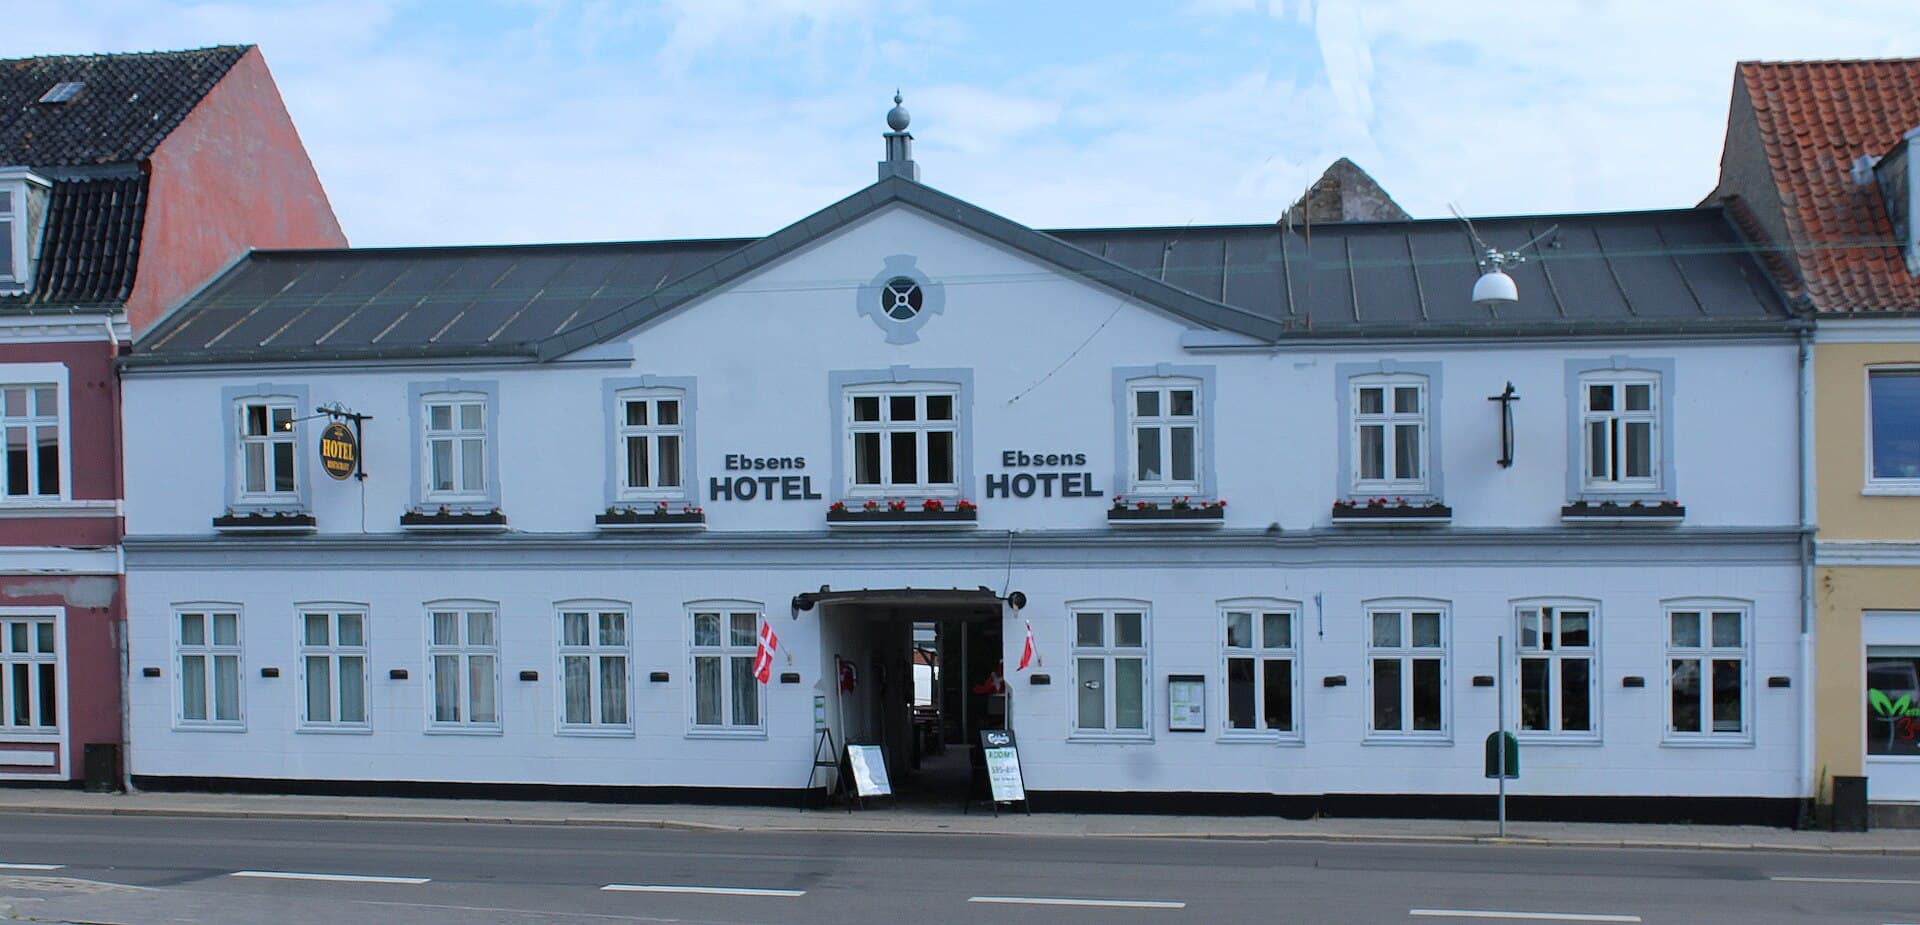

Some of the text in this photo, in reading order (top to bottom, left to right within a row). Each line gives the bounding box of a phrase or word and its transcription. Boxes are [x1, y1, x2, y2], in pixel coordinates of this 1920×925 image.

[322, 438, 354, 460] HOTEL
[1002, 450, 1087, 467] Ebsens
[725, 454, 806, 471] Ebsens
[710, 475, 822, 501] HOTEL
[986, 472, 1104, 499] HOTEL
